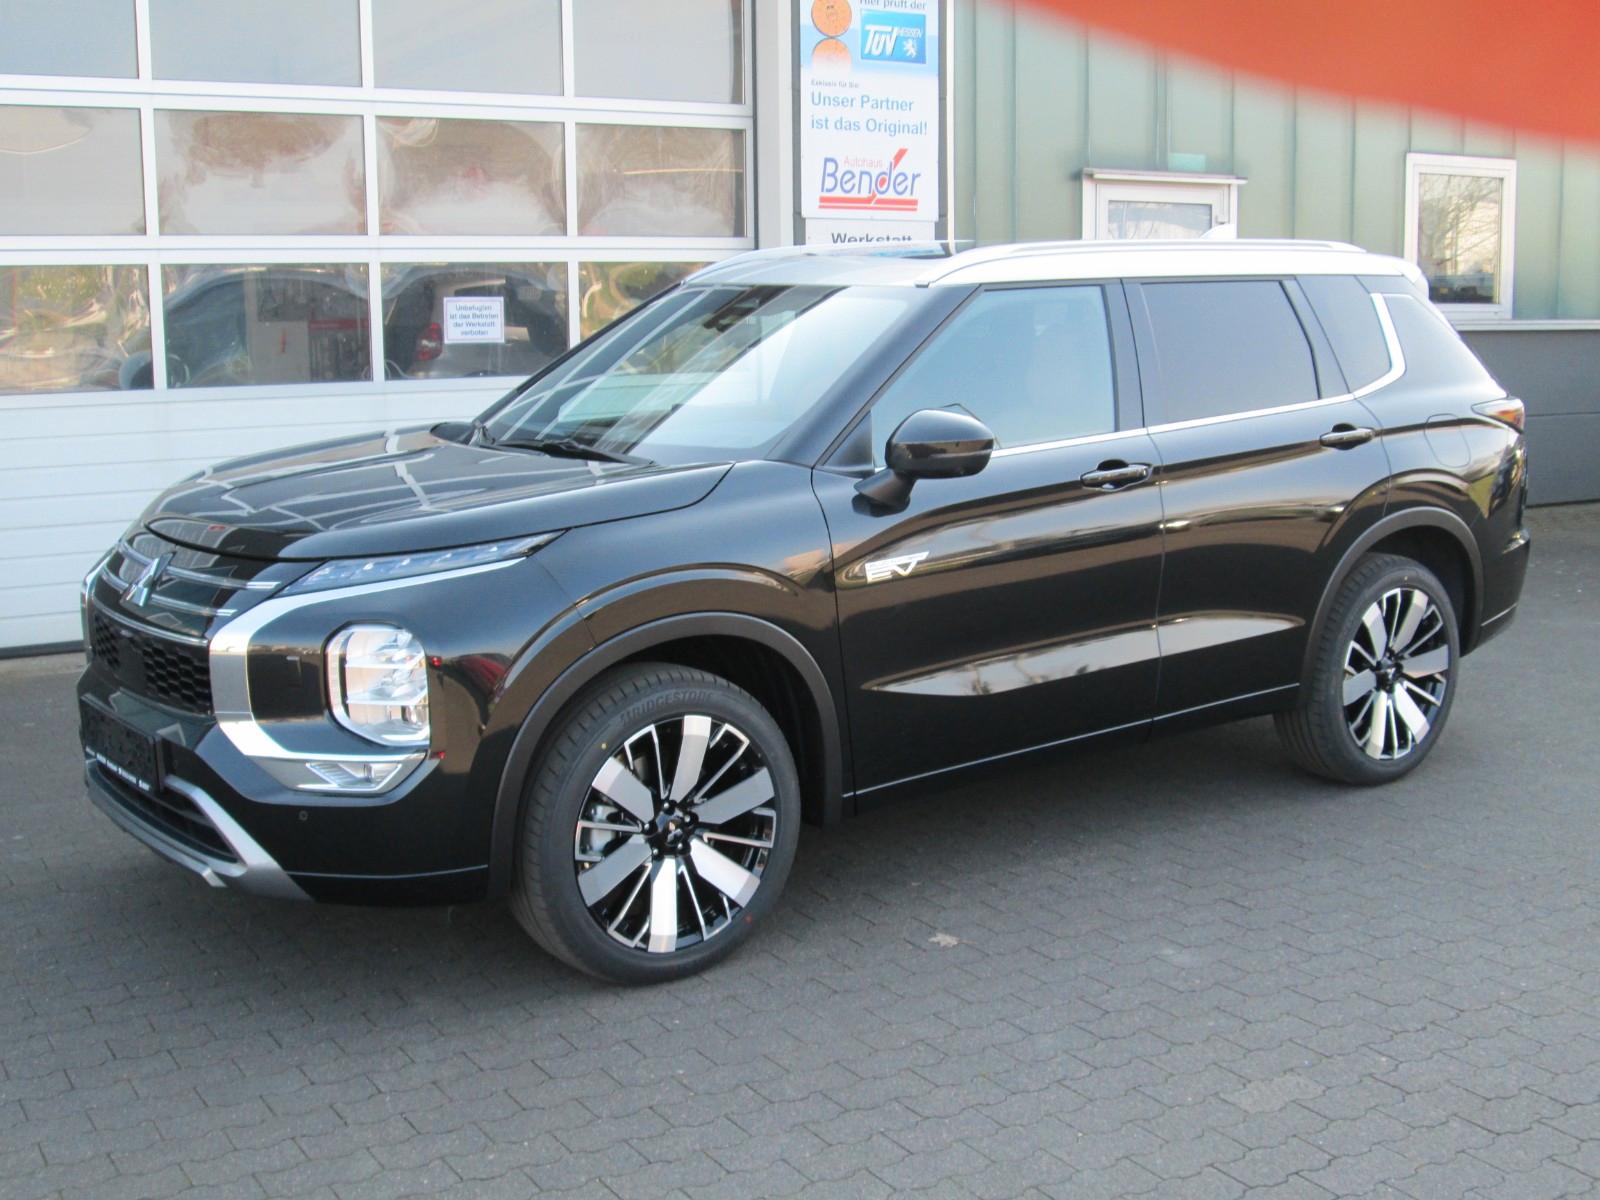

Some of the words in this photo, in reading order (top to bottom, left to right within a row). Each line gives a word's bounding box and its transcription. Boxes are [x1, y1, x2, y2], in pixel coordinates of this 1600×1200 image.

[910, 0, 927, 9] der
[811, 91, 856, 107] Unser
[861, 95, 914, 112] Partner
[811, 114, 829, 130] ist
[834, 116, 861, 131] das
[866, 118, 928, 137] Original!
[843, 156, 885, 168] Autohaus
[821, 157, 921, 196] Bender
